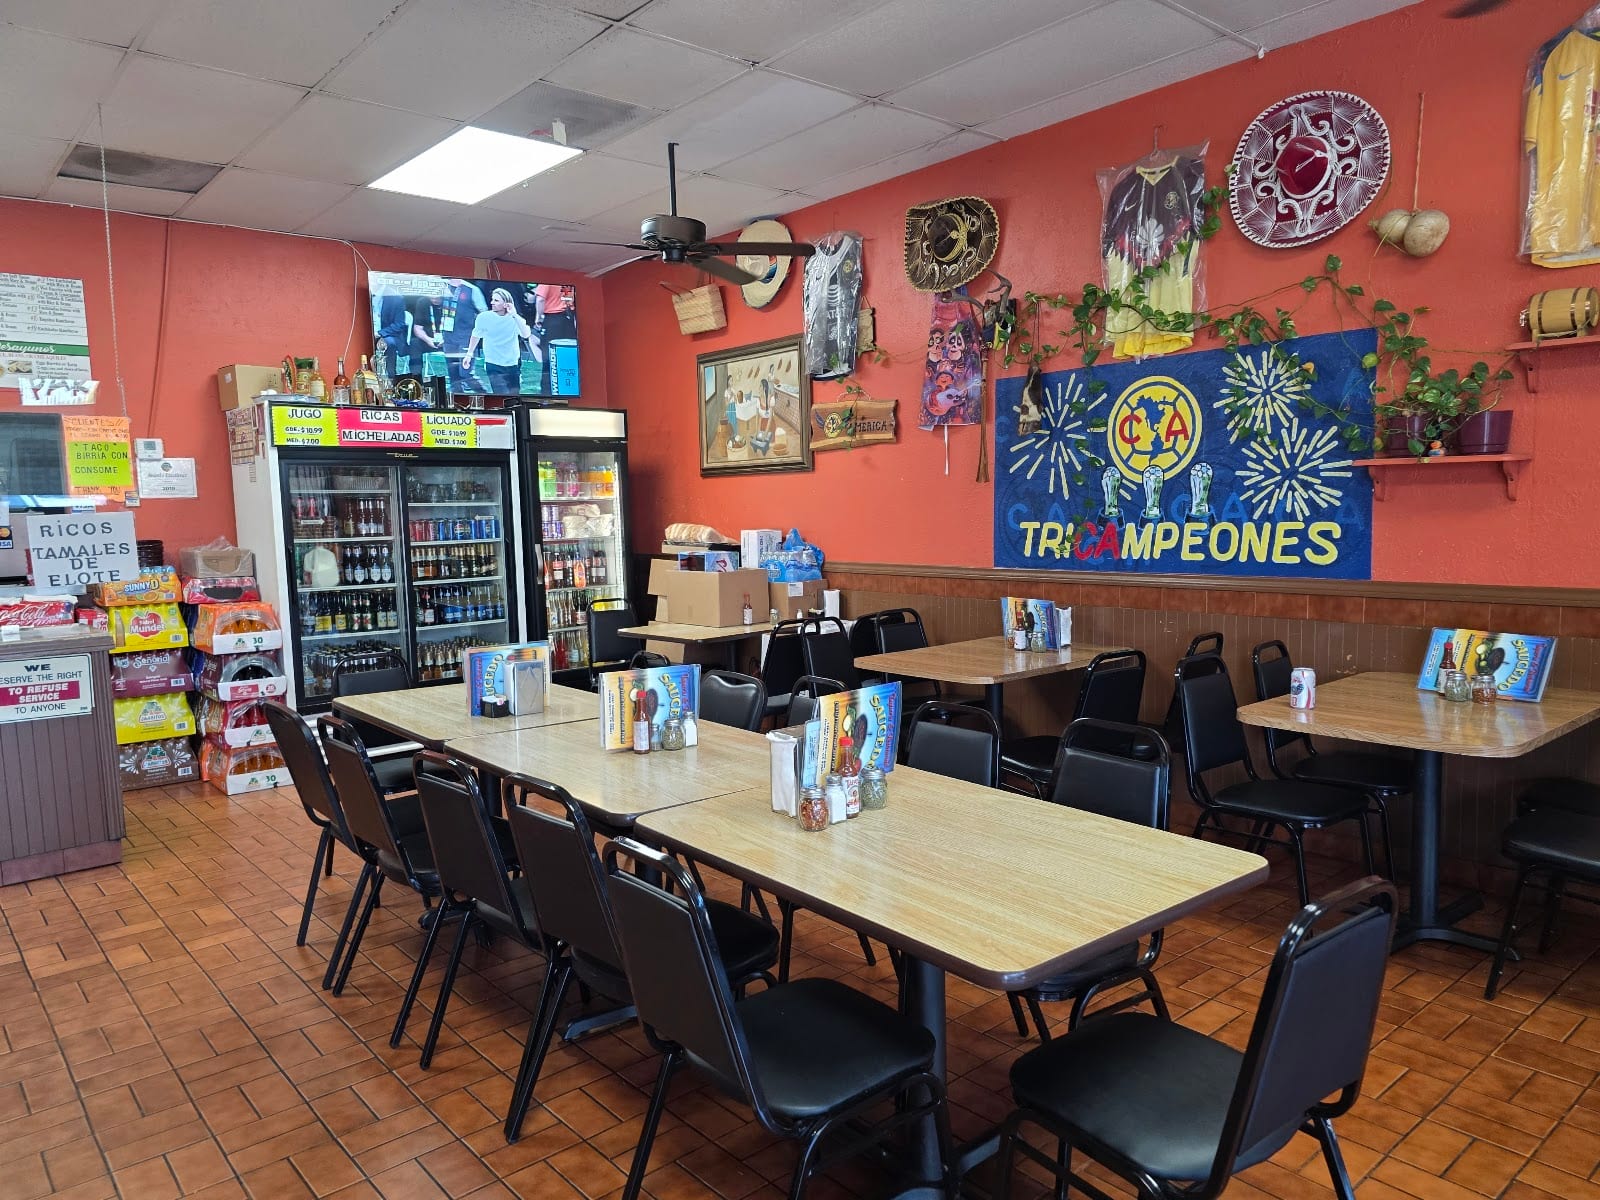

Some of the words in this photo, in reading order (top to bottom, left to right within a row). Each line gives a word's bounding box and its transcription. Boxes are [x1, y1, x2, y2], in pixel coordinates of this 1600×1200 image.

[288, 409, 322, 418] JUGO
[361, 410, 400, 421] RICAS
[855, 420, 887, 432] MERICA
[1119, 414, 1142, 444] C
[1165, 410, 1189, 442] A
[76, 452, 107, 460] BIRRIA
[111, 451, 128, 460] CON
[74, 466, 119, 474] CONSOME
[1020, 521, 1341, 565] TRICAMPEONES
[32, 542, 131, 560] TAMALES
[69, 557, 98, 570] DE
[48, 569, 121, 587] ELOTE
[129, 622, 166, 634] Mundet
[253, 636, 263, 644] 30
[133, 653, 170, 668] Señorial
[1497, 639, 1529, 691] SAUCEDO
[24, 664, 51, 672] WE
[0, 676, 33, 685] ESERVE
[36, 674, 53, 682] THE
[57, 671, 83, 680] RIGHT
[8, 687, 22, 695] TO
[27, 683, 69, 694] REFUSE
[19, 692, 60, 703] SERVICE
[31, 703, 66, 712] ANYONE
